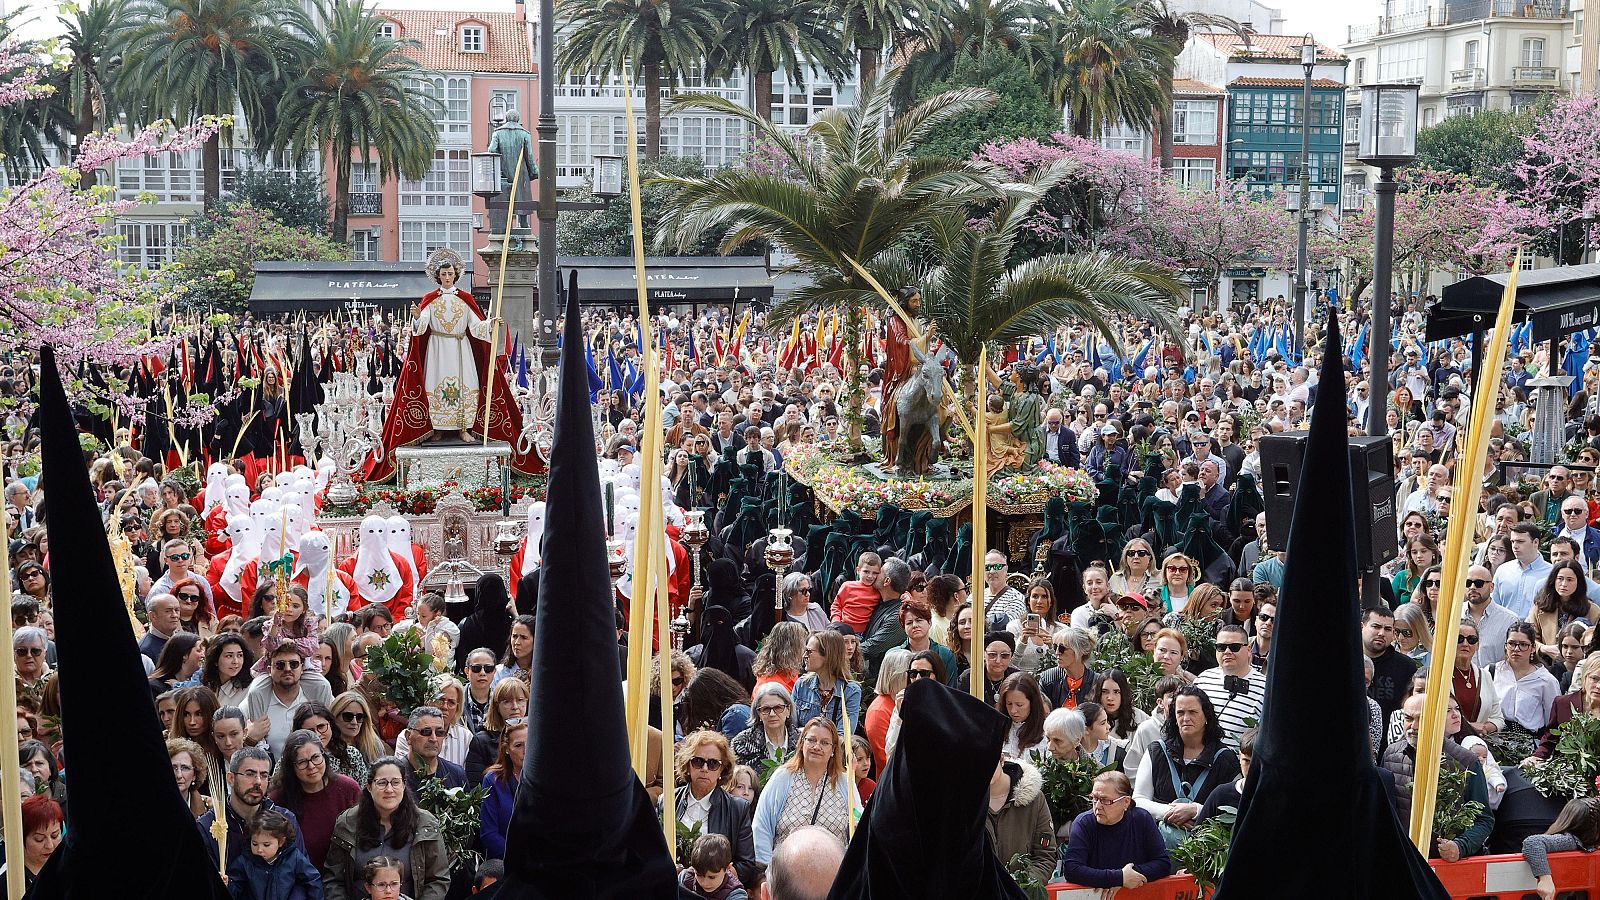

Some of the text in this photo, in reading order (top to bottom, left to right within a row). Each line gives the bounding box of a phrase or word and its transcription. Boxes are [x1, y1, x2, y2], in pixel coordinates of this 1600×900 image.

[328, 281, 373, 289] PLATEA
[654, 290, 674, 298] PLATEA
[344, 301, 365, 309] PLATEA
